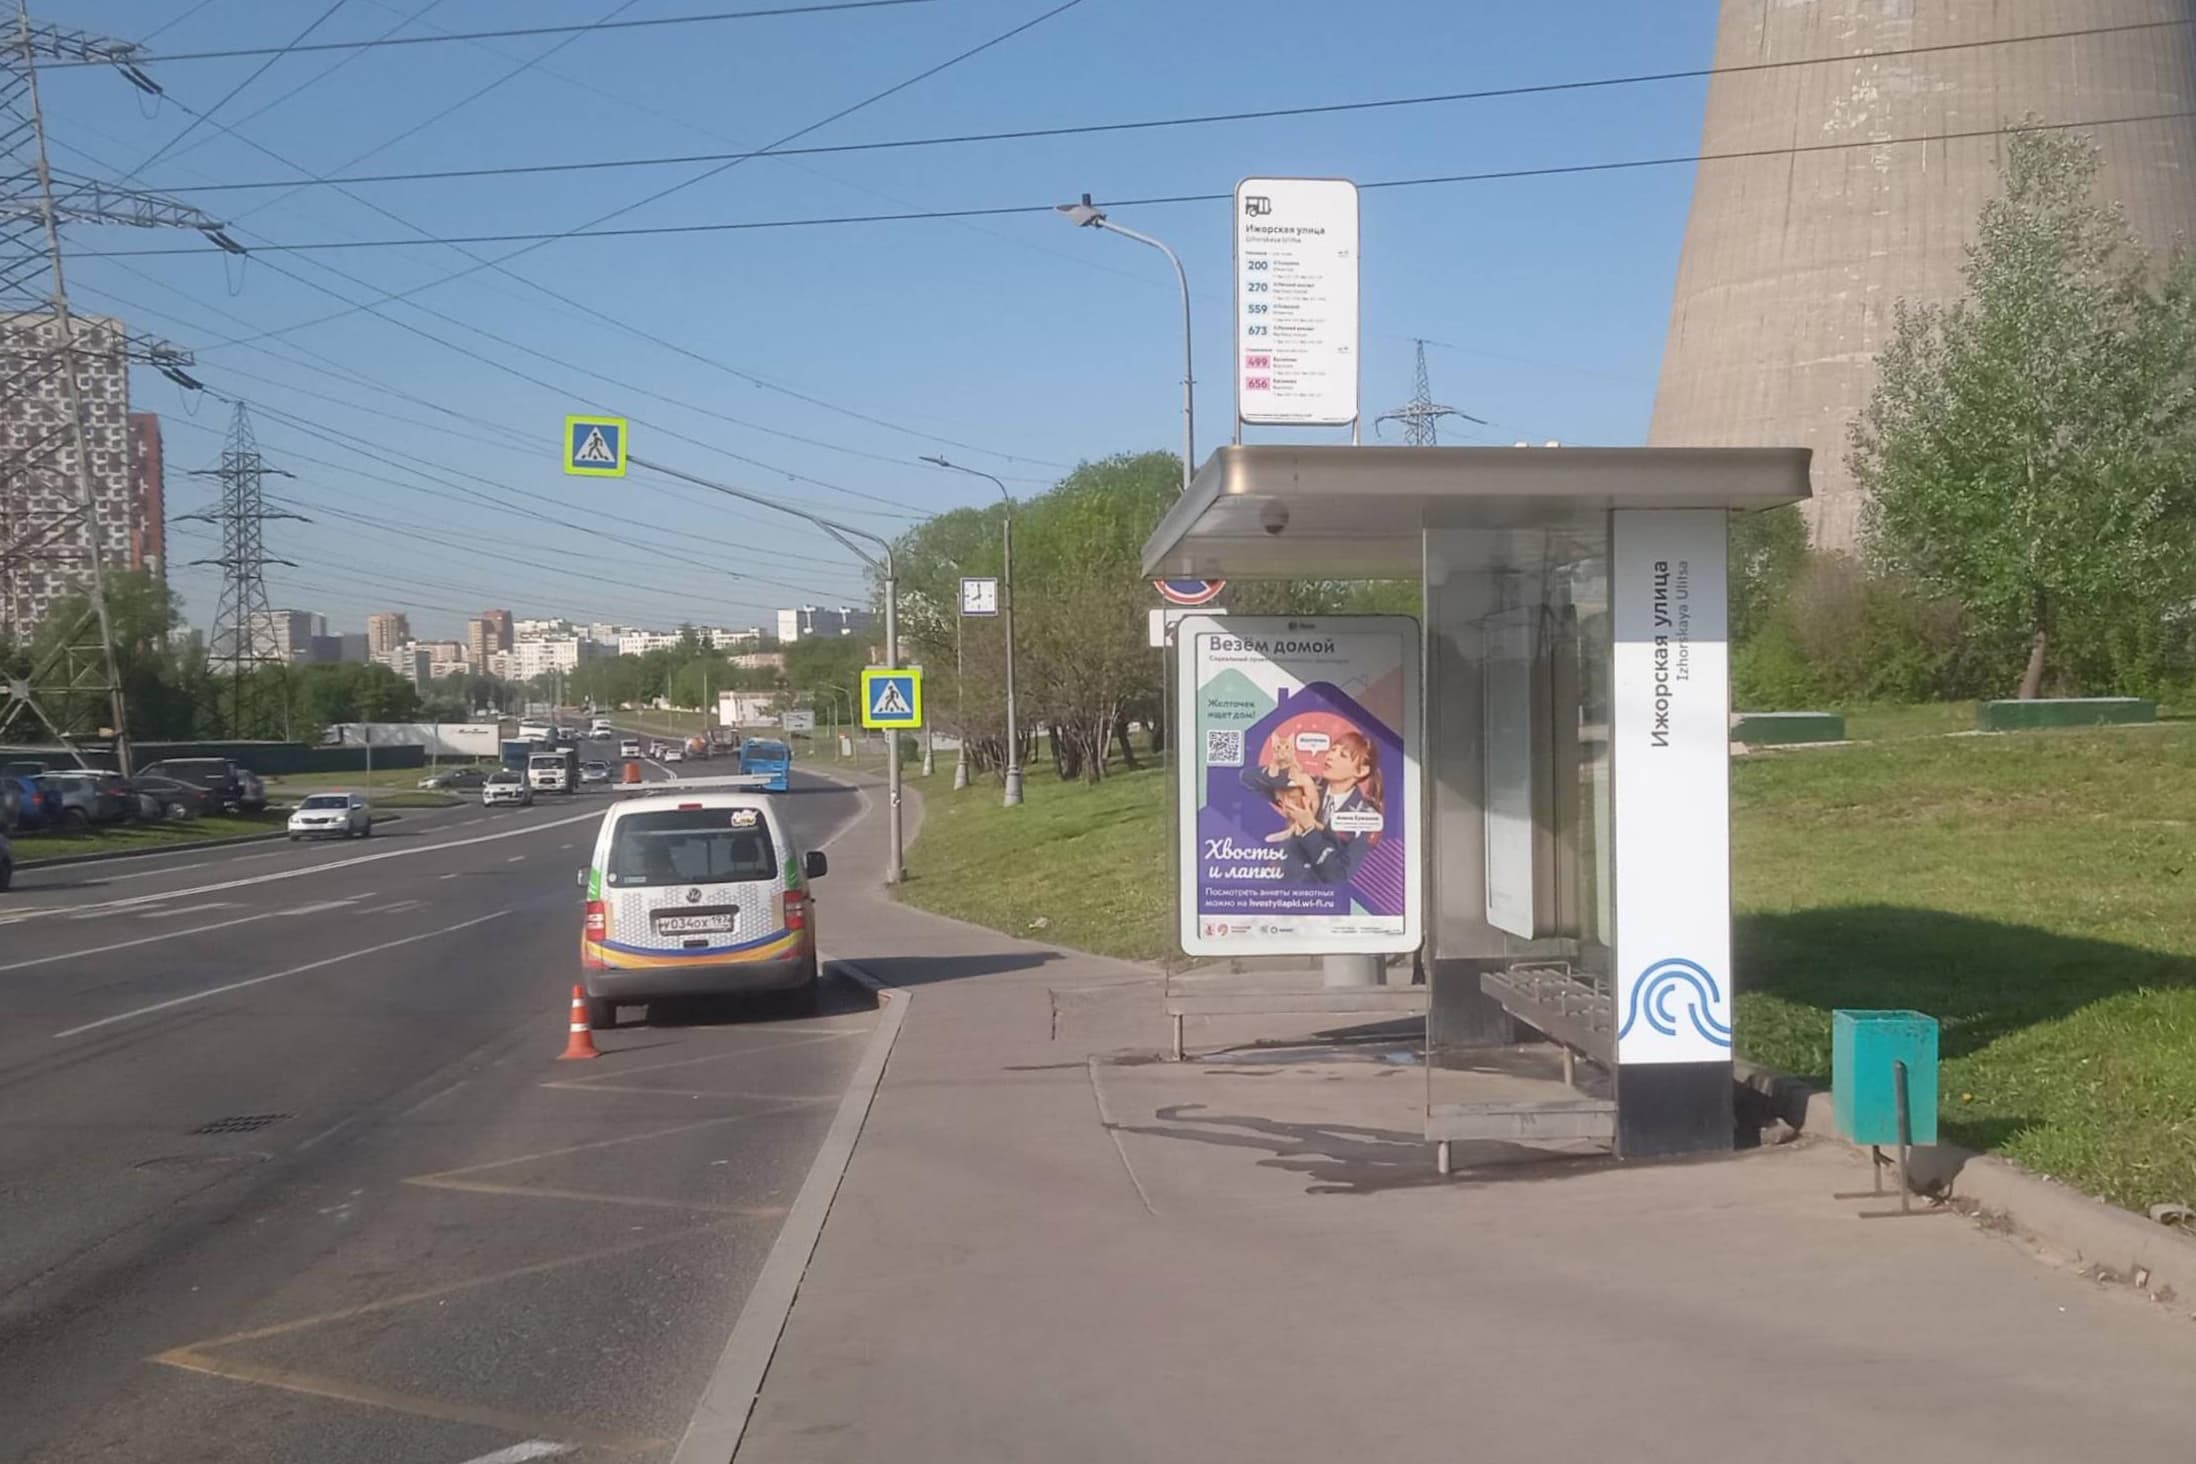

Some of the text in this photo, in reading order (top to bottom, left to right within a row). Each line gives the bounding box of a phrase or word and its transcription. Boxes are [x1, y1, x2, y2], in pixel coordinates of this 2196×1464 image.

[1245, 223, 1326, 236] Ижорская улица
[1247, 260, 1268, 271] 200
[1247, 282, 1268, 292] 270
[1247, 304, 1268, 314] 559
[1248, 326, 1268, 336] 673
[1247, 357, 1268, 367] 499
[1248, 380, 1268, 389] 656
[1676, 560, 1691, 681] Izhorskaya Ulitsa
[1209, 636, 1335, 654] Везём домой
[1651, 560, 1672, 748] Ижорская улица
[1208, 700, 1255, 709] Желточек
[1232, 711, 1256, 720] дом!
[1205, 837, 1288, 860] Хвосты
[1209, 865, 1284, 879] и лапки
[1205, 887, 1335, 897] Посмотреть анкеты животных
